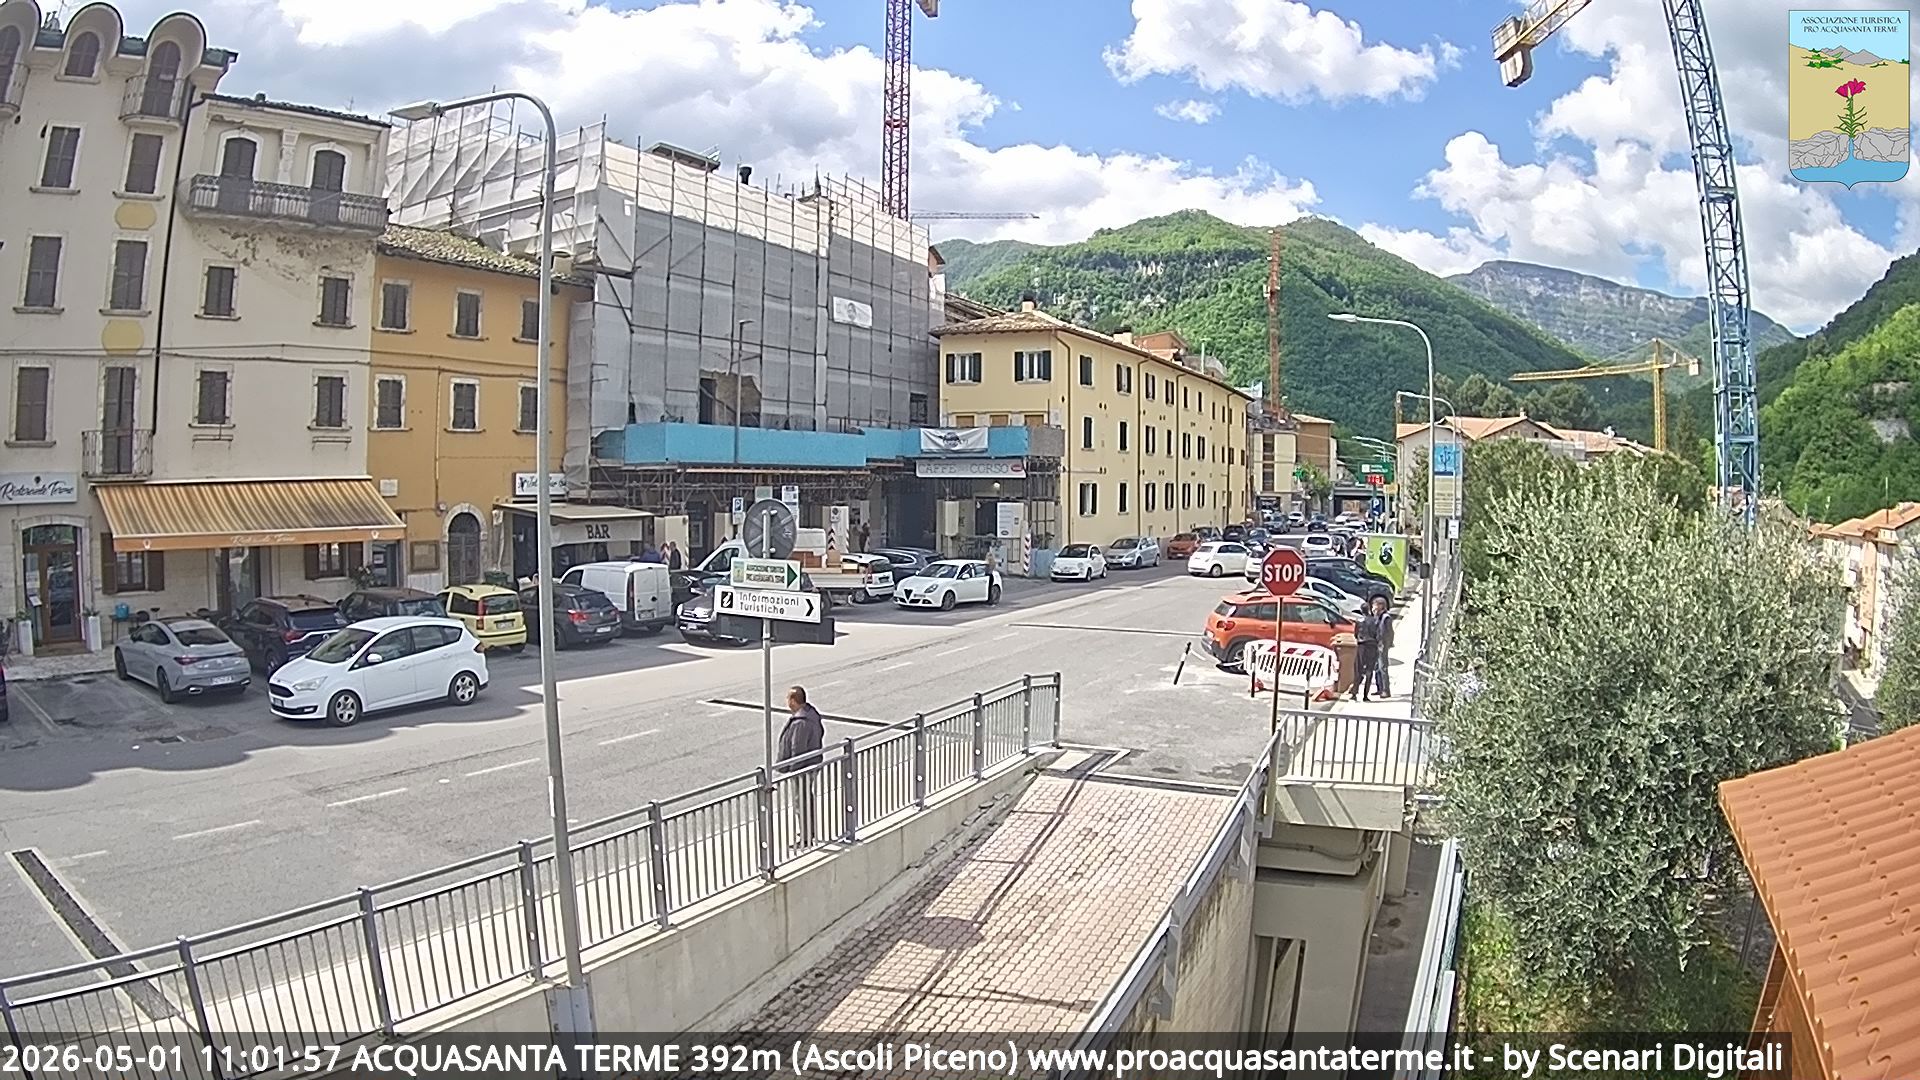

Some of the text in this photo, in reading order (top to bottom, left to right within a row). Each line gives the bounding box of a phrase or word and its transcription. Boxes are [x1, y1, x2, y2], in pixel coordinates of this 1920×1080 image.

[970, 463, 1009, 475] CORSO
[585, 524, 610, 539] BAR
[1264, 563, 1303, 583] STOP
[739, 592, 800, 606] Informazioni
[740, 601, 785, 615] Turistiche
